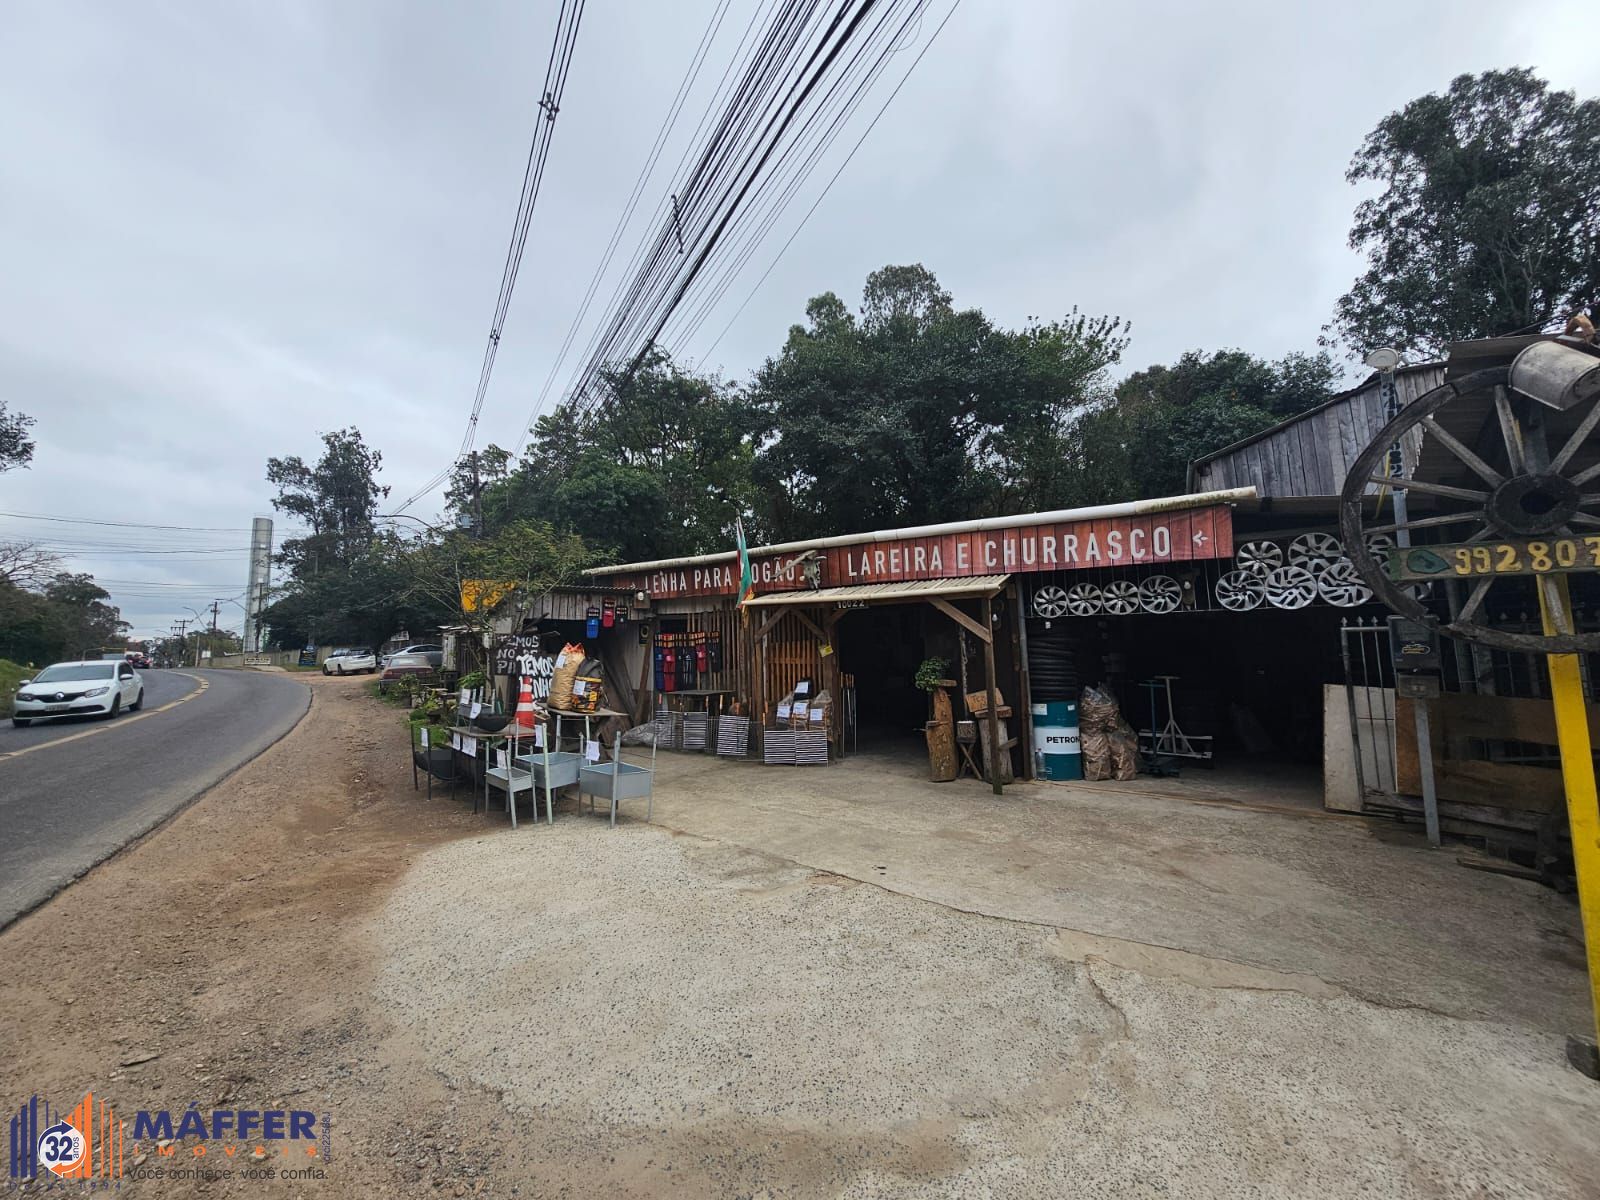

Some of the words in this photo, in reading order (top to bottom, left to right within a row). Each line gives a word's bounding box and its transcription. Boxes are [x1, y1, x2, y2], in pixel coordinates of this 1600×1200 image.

[645, 571, 687, 594] LENHA
[694, 566, 732, 590] PARA
[751, 556, 795, 583] OGÃO
[848, 545, 943, 577] LAREIRA
[957, 543, 969, 569] E
[984, 526, 1170, 567] CHURRASCO
